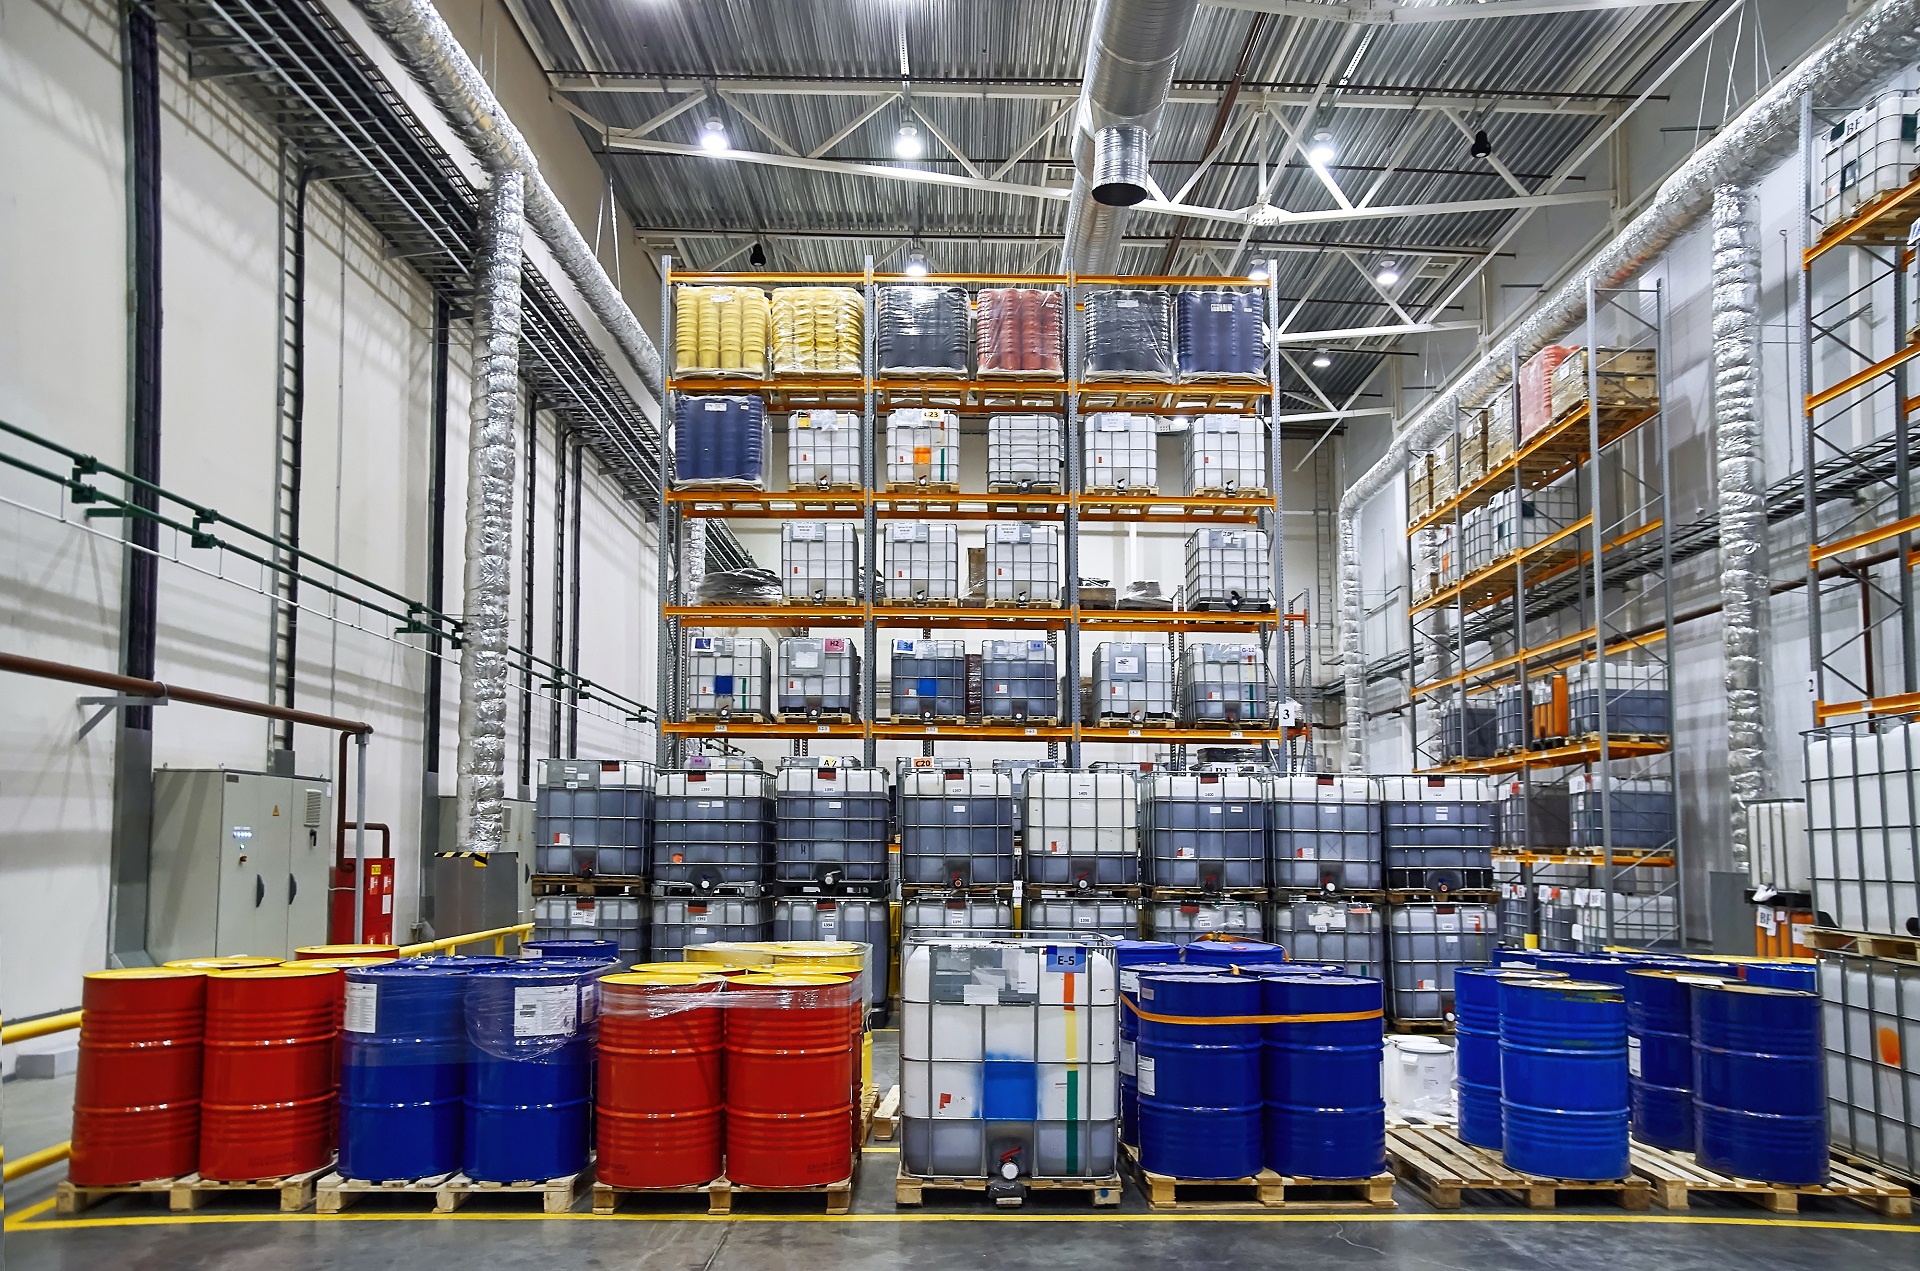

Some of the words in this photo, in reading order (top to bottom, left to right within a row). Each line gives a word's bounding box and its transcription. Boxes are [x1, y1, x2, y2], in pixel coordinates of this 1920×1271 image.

[1847, 116, 1863, 136] BF
[1282, 708, 1291, 720] 3
[1760, 911, 1773, 925] BF
[1057, 955, 1075, 966] E-5
